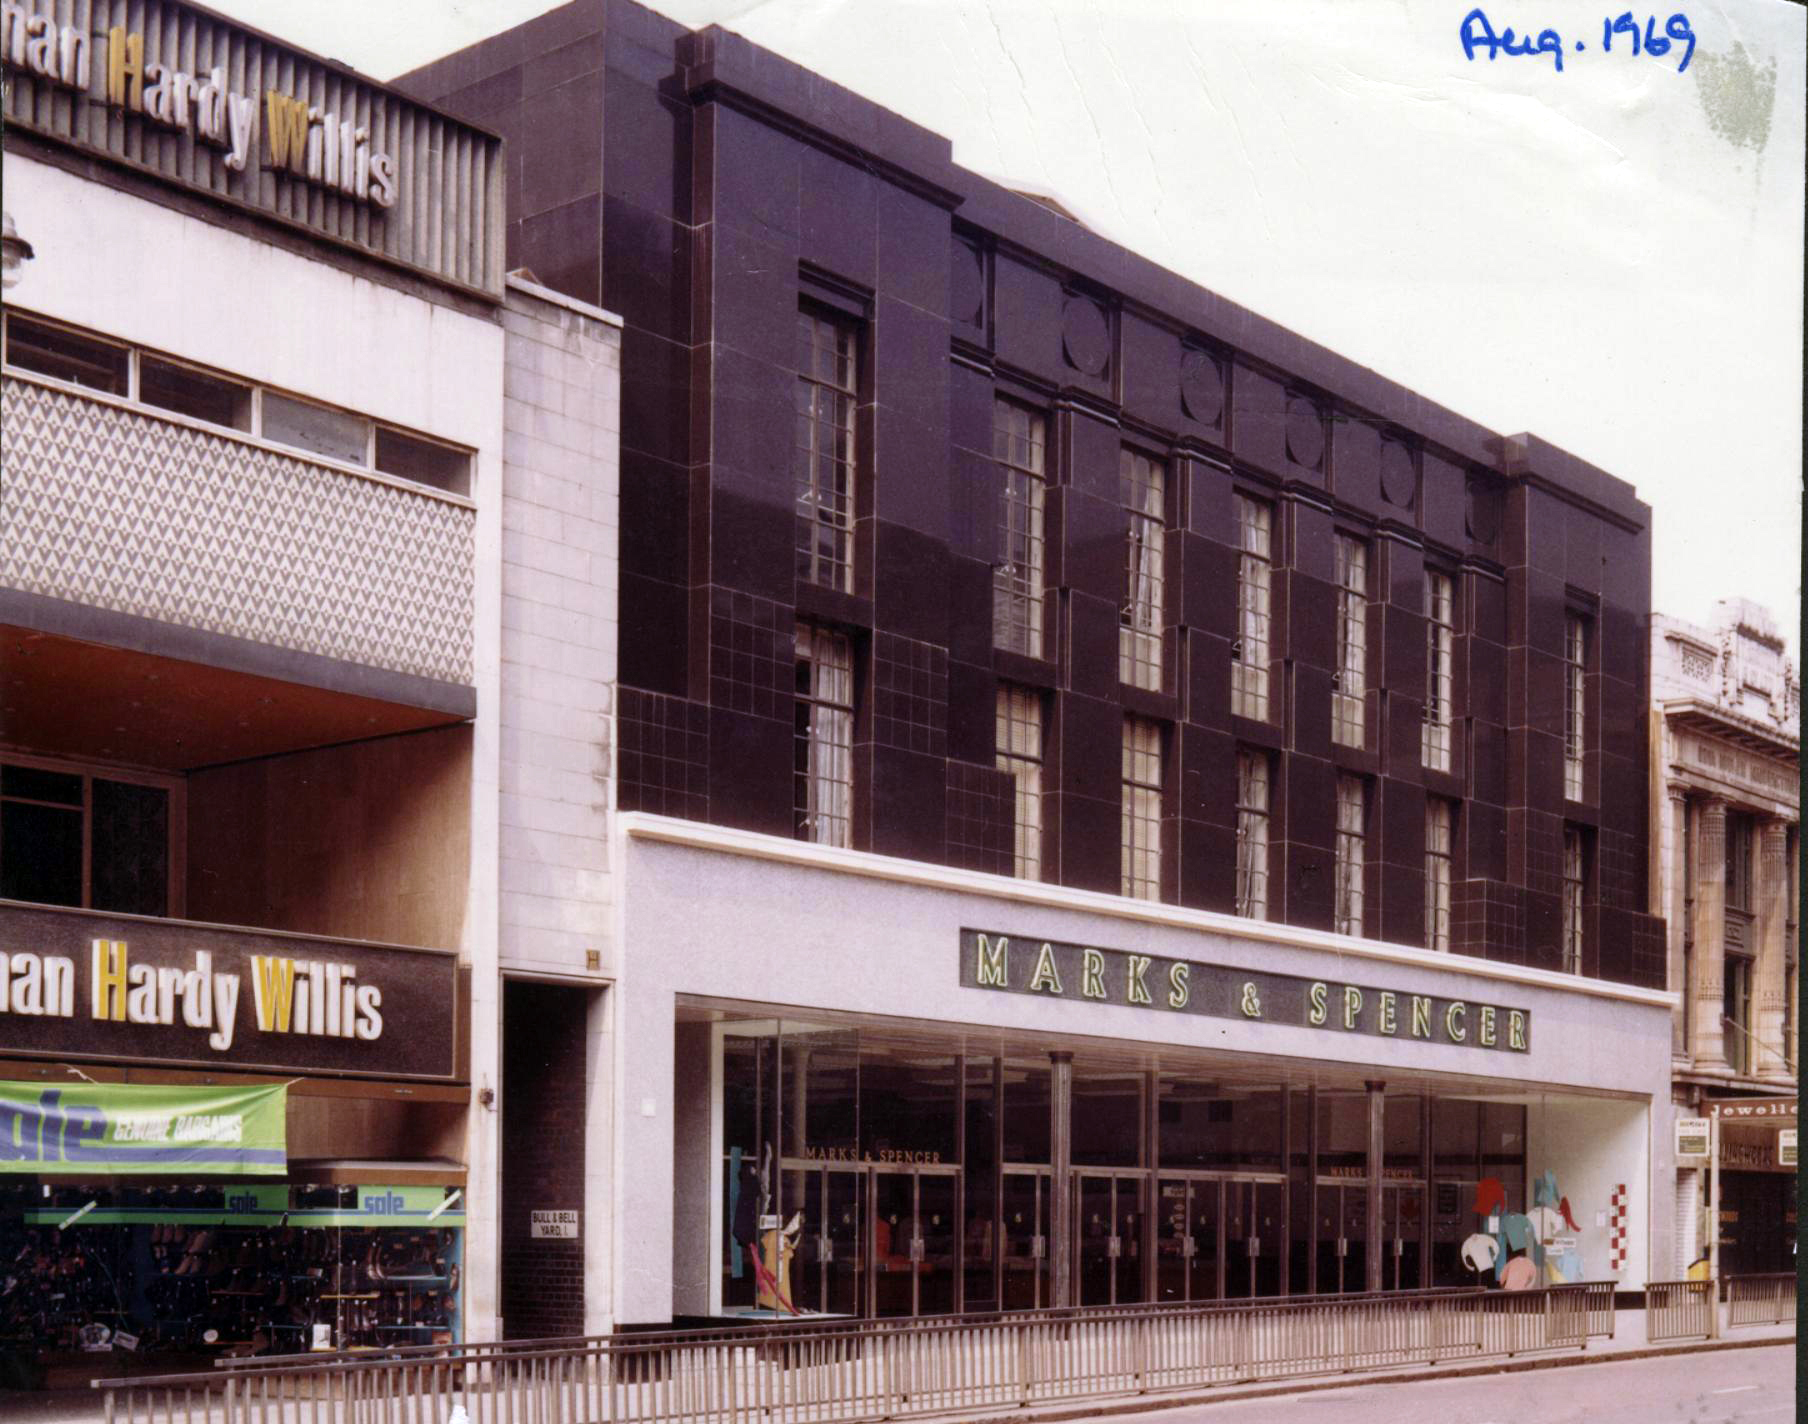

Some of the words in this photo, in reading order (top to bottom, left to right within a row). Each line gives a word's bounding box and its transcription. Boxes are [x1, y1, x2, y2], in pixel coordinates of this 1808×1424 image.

[109, 26, 254, 171] Hardy
[267, 90, 394, 208] Willis
[92, 938, 240, 1050] Hardy
[251, 955, 383, 1040] Willis
[977, 934, 1189, 1008] MARKS
[1241, 982, 1261, 1018] &
[1310, 982, 1527, 1050] SPENCER
[806, 1147, 857, 1161] MARKS
[864, 1151, 871, 1162] &
[880, 1150, 941, 1164] SPENCER
[229, 1191, 259, 1215] sale
[364, 1191, 405, 1216] sale
[533, 1212, 550, 1223] BULL
[559, 1212, 576, 1223] BELL
